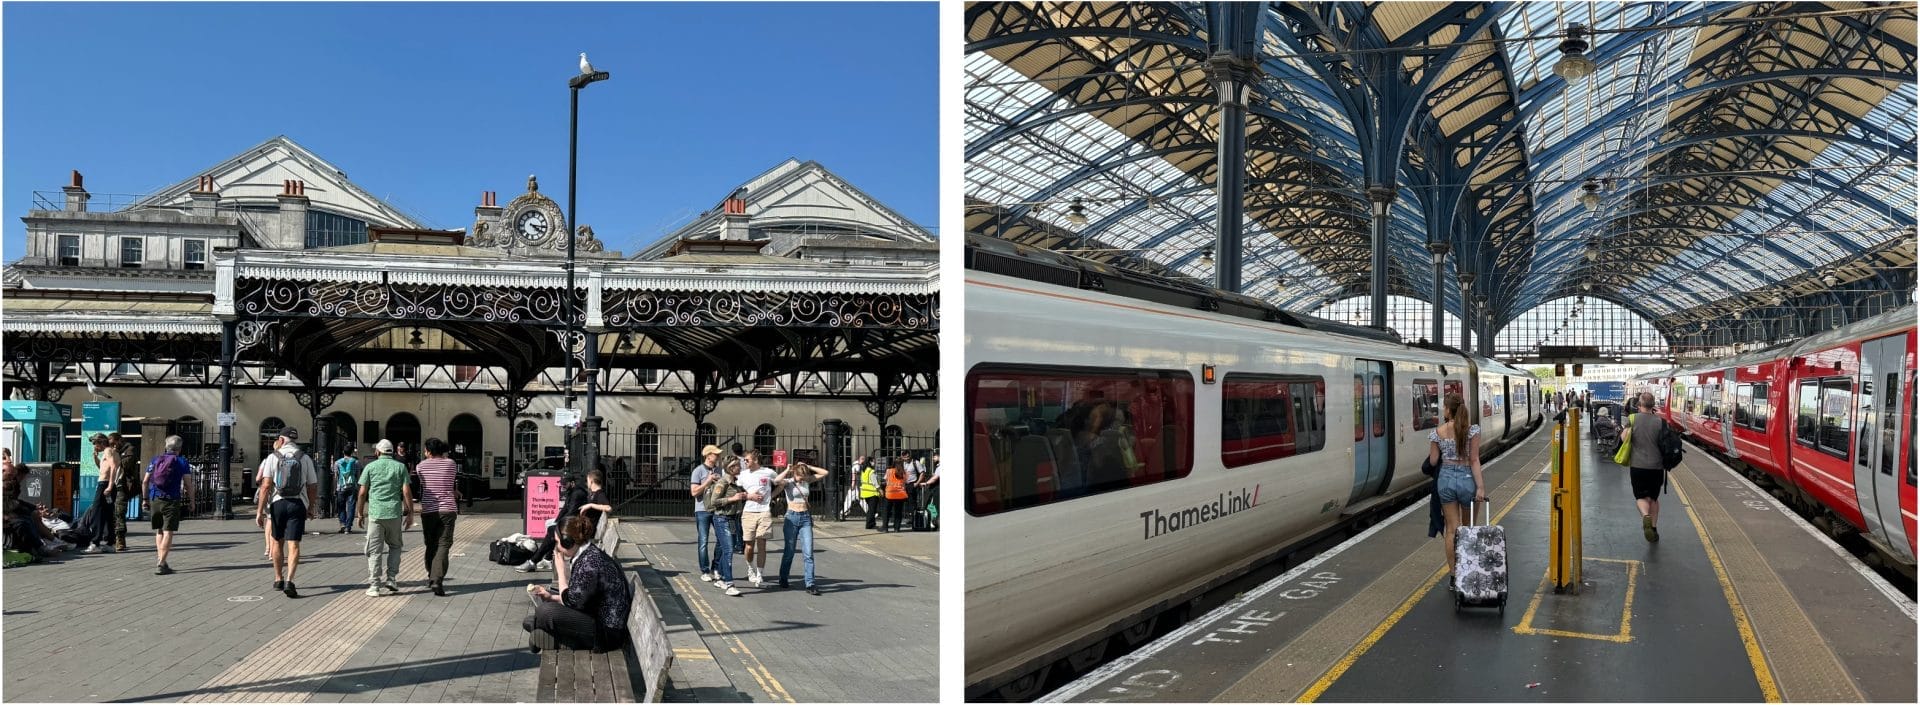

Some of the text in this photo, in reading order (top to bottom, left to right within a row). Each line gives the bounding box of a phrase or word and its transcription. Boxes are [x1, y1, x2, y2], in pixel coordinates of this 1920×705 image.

[1140, 487, 1251, 540] ThamesLink
[1191, 609, 1287, 646] THE
[1279, 571, 1343, 600] GAP
